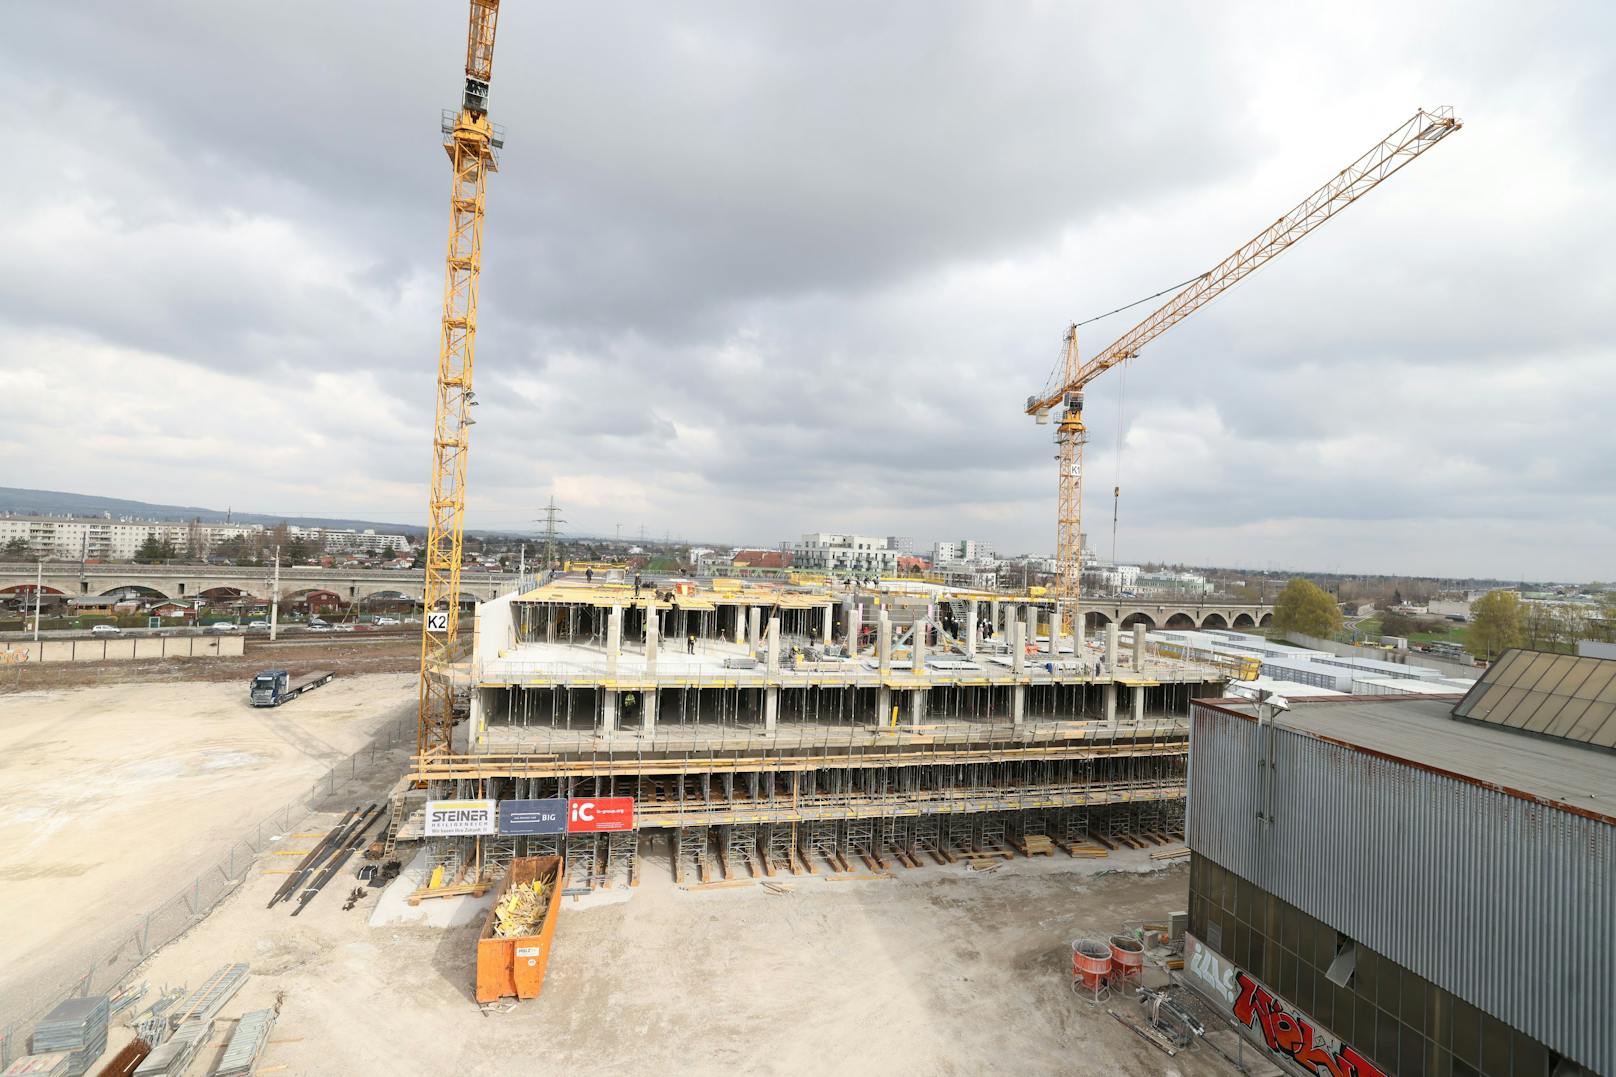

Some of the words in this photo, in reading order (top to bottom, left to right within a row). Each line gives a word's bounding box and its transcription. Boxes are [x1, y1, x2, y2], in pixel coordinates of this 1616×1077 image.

[428, 615, 446, 628] K2
[432, 810, 488, 822] STEINER
[572, 803, 596, 822] iC
